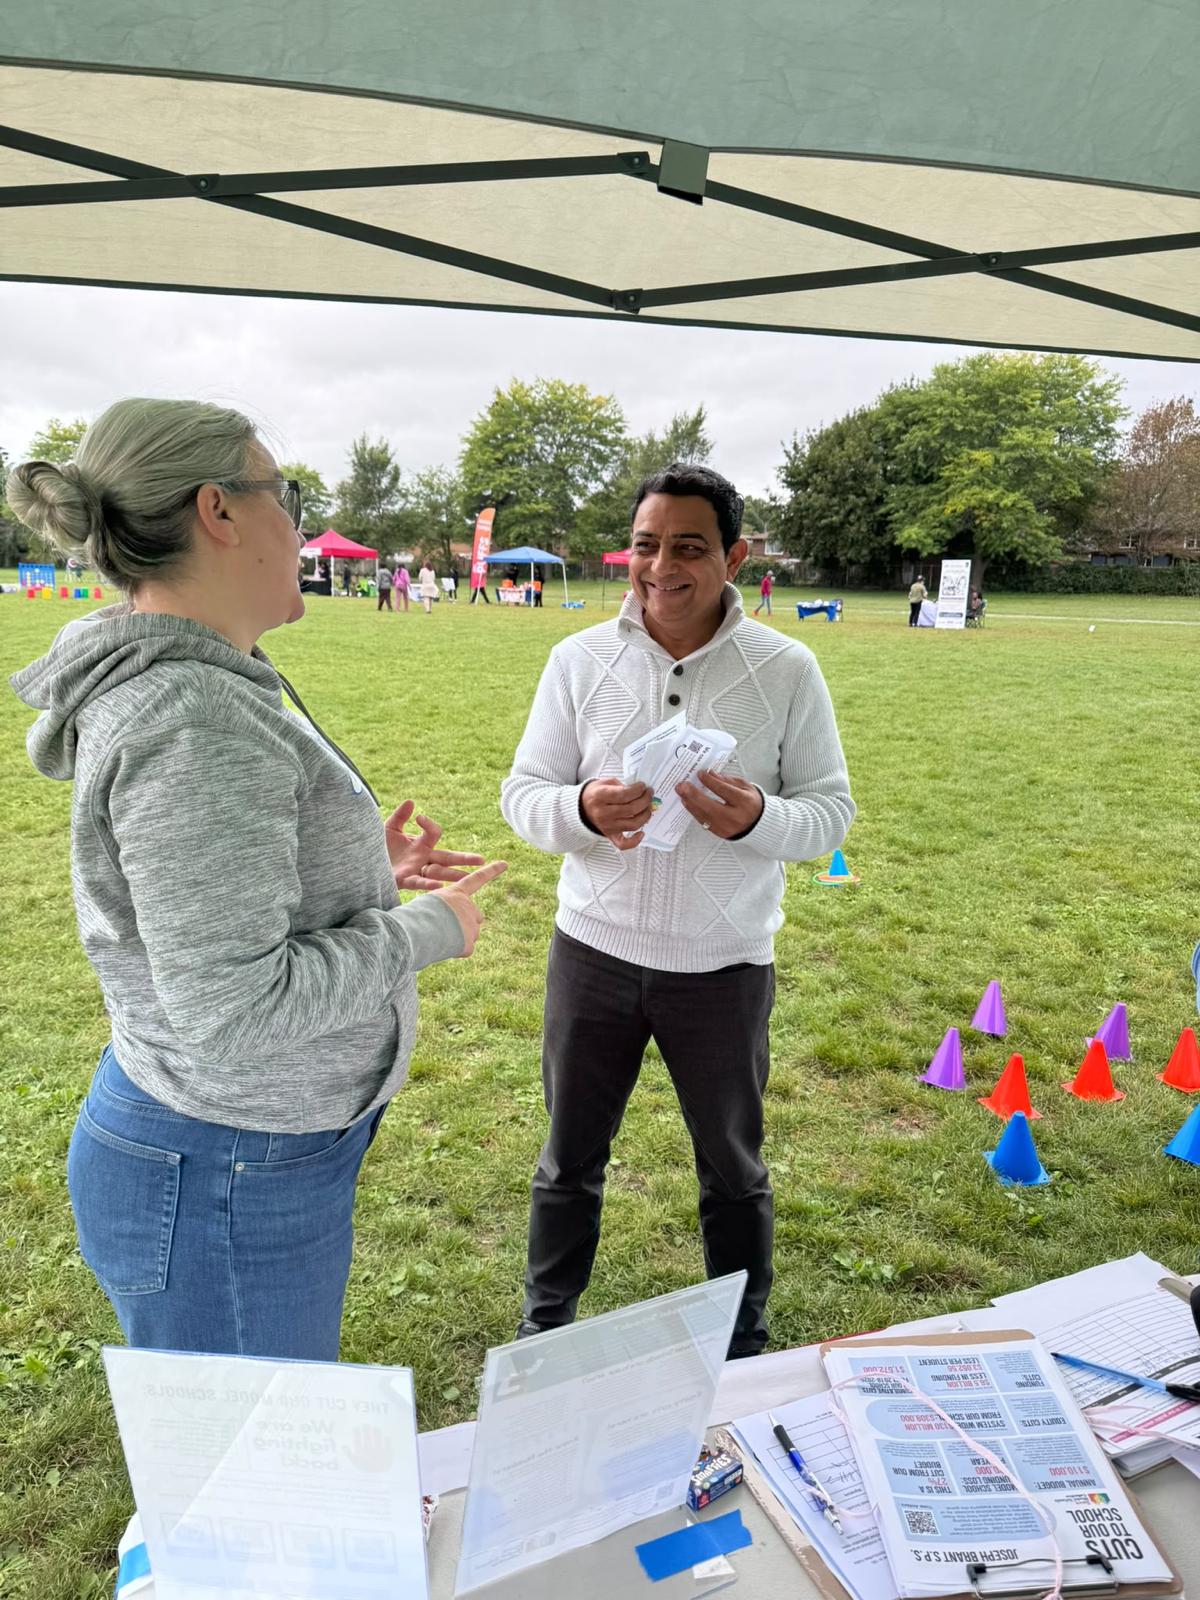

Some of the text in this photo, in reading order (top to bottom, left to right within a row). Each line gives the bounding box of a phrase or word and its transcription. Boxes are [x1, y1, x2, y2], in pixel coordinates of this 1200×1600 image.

[948, 1358, 963, 1366] PER
[930, 1374, 960, 1382] FUNDING
[969, 1372, 987, 1380] LESS
[1015, 1380, 1044, 1388] FUNDING
[964, 1412, 979, 1420] OUR
[980, 1411, 1002, 1420] FROM
[976, 1420, 1006, 1428] SYSTEM
[1040, 1416, 1066, 1426] EQUITY
[904, 1423, 934, 1432] MILLION
[970, 1458, 990, 1466] YEAR
[908, 1468, 930, 1476] FROM
[930, 1469, 944, 1477] CUT
[982, 1476, 1011, 1484] UNDING
[962, 1484, 1018, 1492] MODEL SCHOOL
[1033, 1479, 1096, 1490] ANNUAL BUDGET:
[934, 1486, 952, 1494] THIS
[1066, 1508, 1122, 1524] SCHOOL
[1078, 1523, 1132, 1538] TO OUR
[1085, 1538, 1144, 1560] CUTS
[910, 1549, 1018, 1562] JOSEPH BRANT S.P.S.
